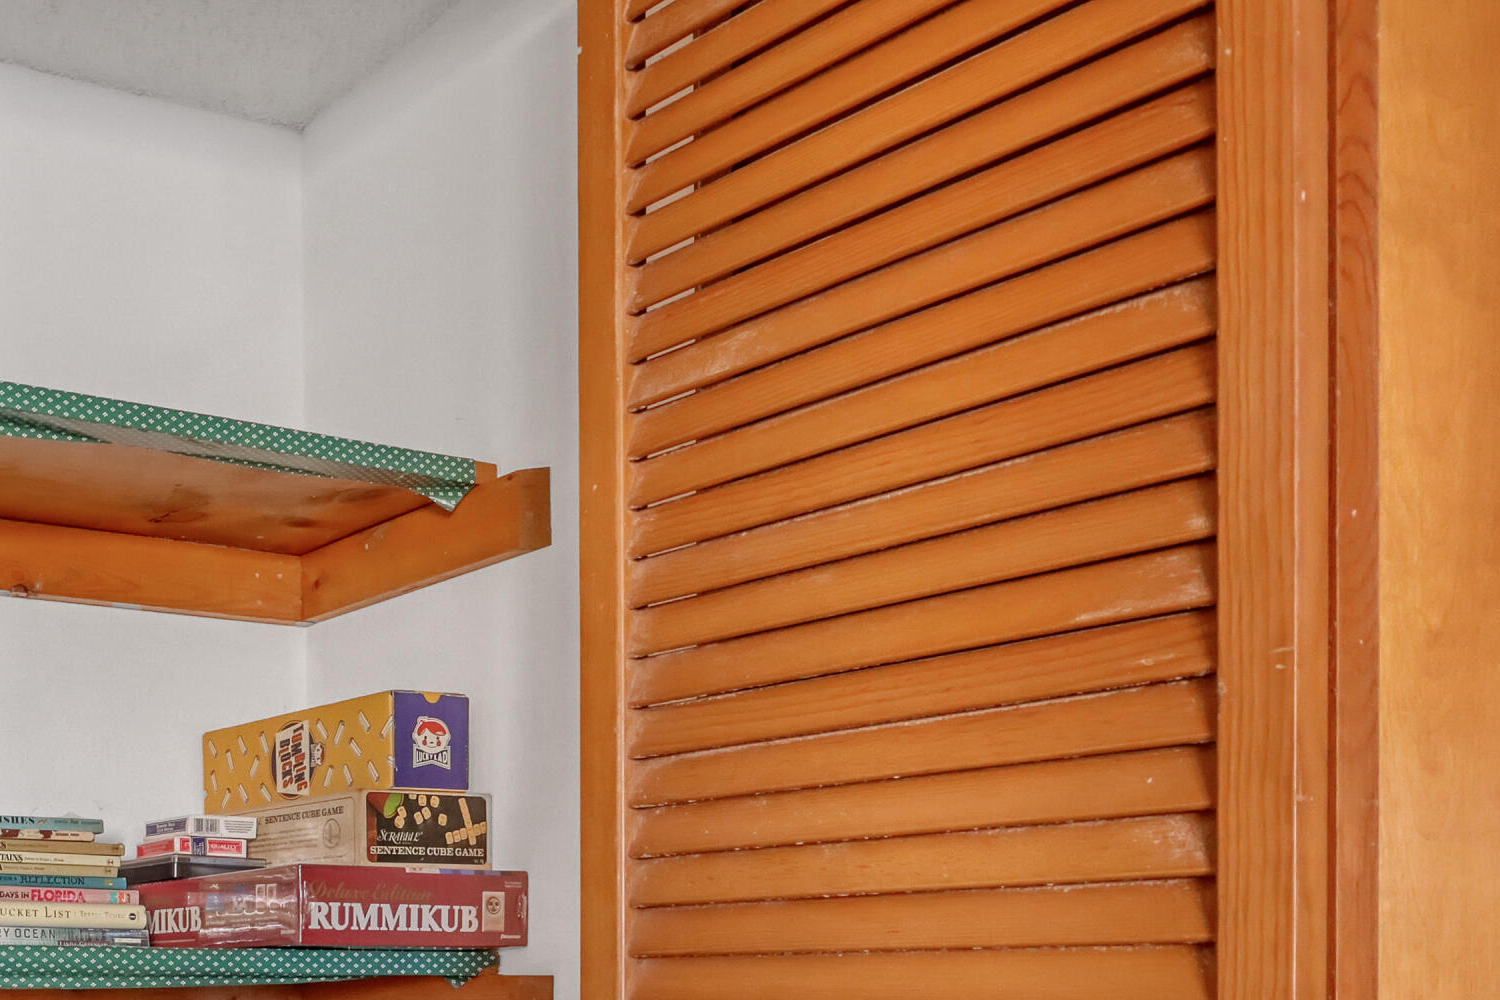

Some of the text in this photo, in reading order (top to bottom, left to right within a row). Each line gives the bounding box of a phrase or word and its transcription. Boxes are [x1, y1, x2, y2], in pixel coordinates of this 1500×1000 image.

[279, 738, 294, 789] BLOCKS
[291, 723, 308, 792] TUMBLING
[264, 805, 344, 825] SENTENCE CUBE GAME
[370, 846, 484, 857] SENTENCE CUBE GAME
[19, 874, 85, 885] REFLECTION
[0, 890, 19, 899] DAYS
[20, 891, 30, 899] IN
[30, 888, 86, 903] FLORIDA
[44, 906, 71, 919] LIST
[308, 901, 480, 933] RUMMIKUB
[14, 928, 56, 939] OCEAN
